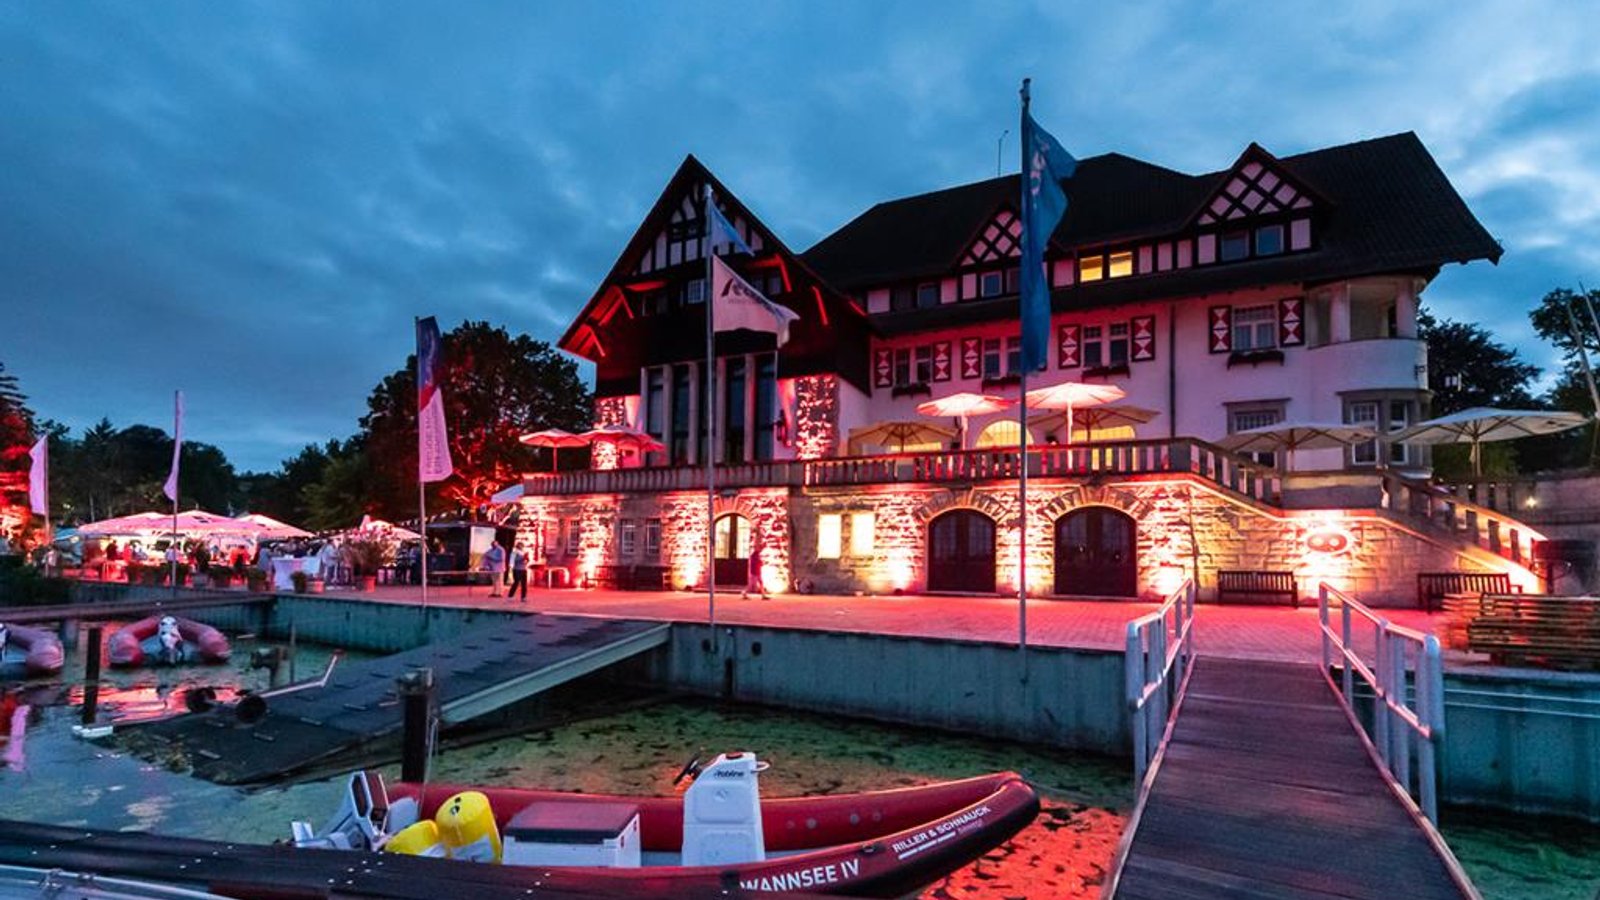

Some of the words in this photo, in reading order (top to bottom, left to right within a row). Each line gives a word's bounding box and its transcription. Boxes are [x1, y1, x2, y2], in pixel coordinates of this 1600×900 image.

[892, 832, 929, 853] RILLER
[928, 829, 937, 838] &
[936, 806, 992, 835] SCHNAUCK
[740, 865, 838, 892] WANNSEE
[840, 858, 859, 879] IV
